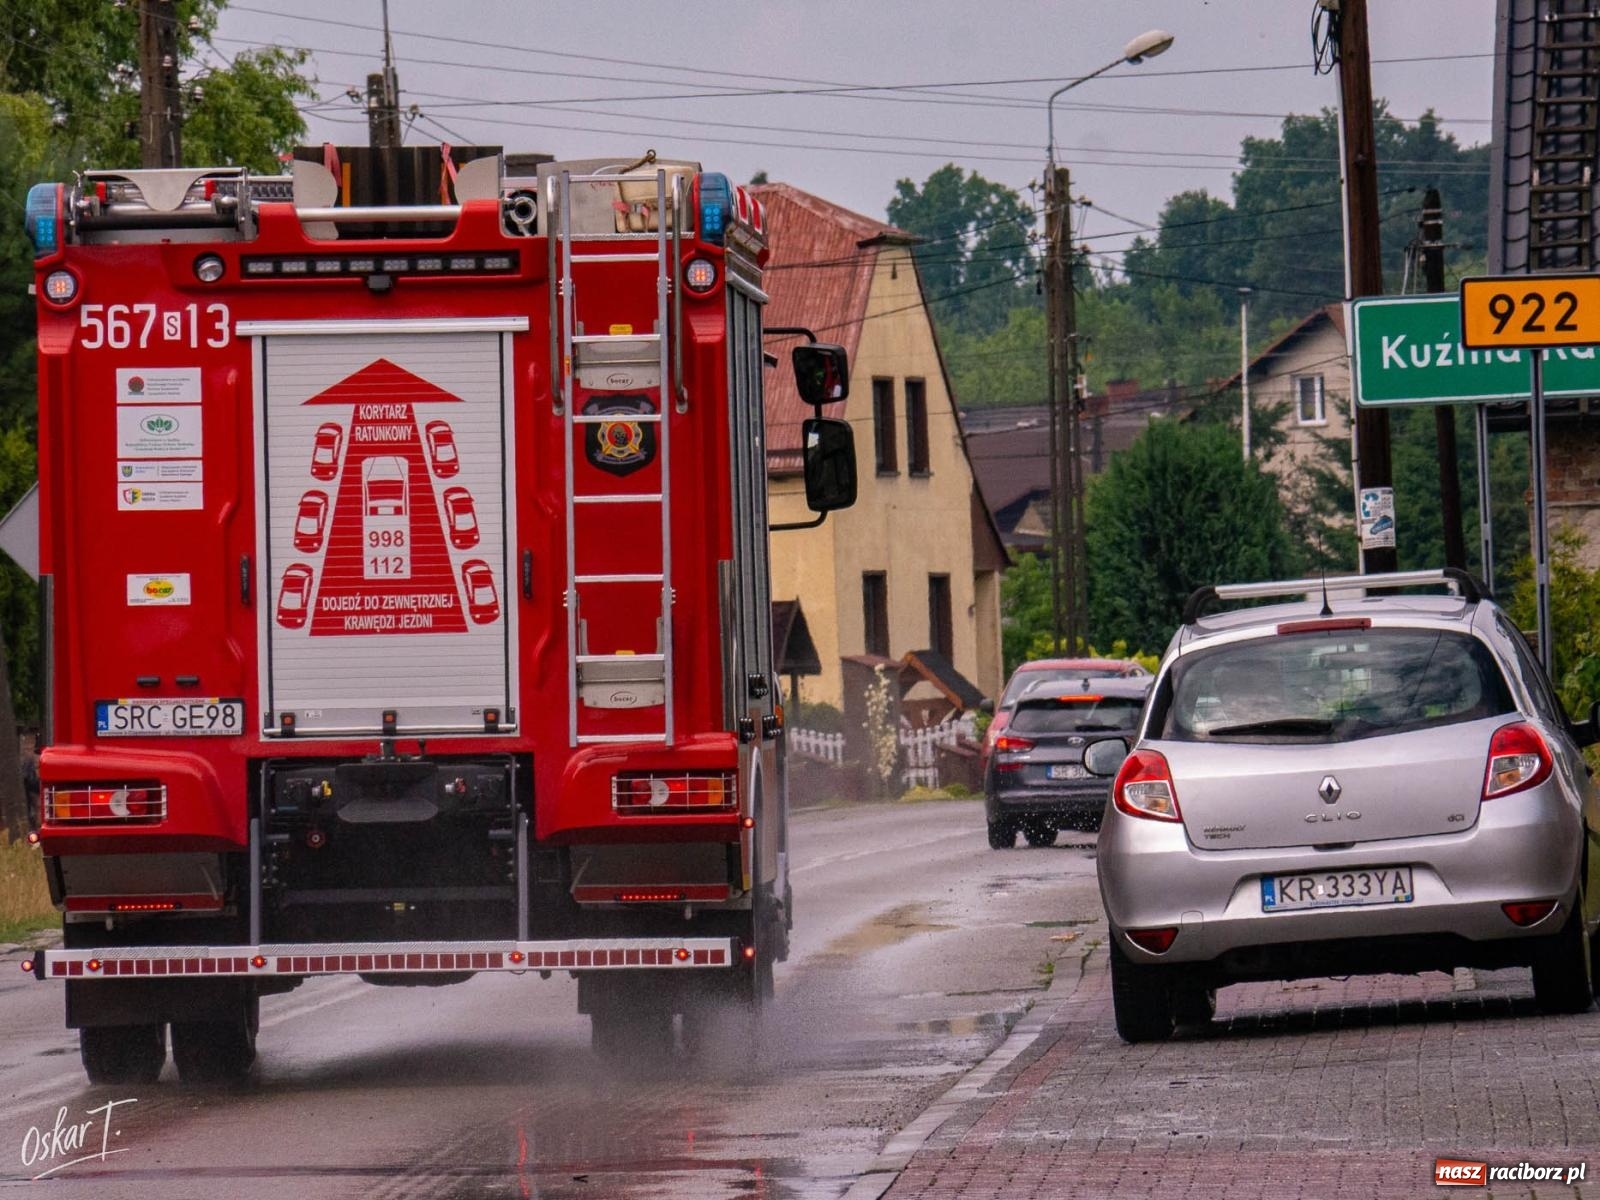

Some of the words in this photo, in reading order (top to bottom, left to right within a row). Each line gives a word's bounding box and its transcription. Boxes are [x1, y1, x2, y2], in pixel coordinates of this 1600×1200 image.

[1489, 291, 1578, 335] 922
[80, 303, 157, 349] 567
[165, 313, 180, 339] S
[186, 303, 230, 349] 13
[359, 403, 408, 420] KORYTARZ
[355, 425, 412, 441] RATUNKOWY
[368, 530, 404, 548] 998
[370, 556, 404, 574] 112
[322, 592, 361, 611] DOJEDŹ
[364, 595, 379, 610] DO
[382, 593, 453, 612] ZEWNĘTRZNEJ
[344, 614, 396, 633] KRAWĘDZI
[114, 705, 162, 730] SRC
[172, 703, 236, 729] GE98
[1304, 811, 1362, 823] CLIO
[1279, 878, 1317, 903] KR
[1326, 870, 1407, 899] 333YA
